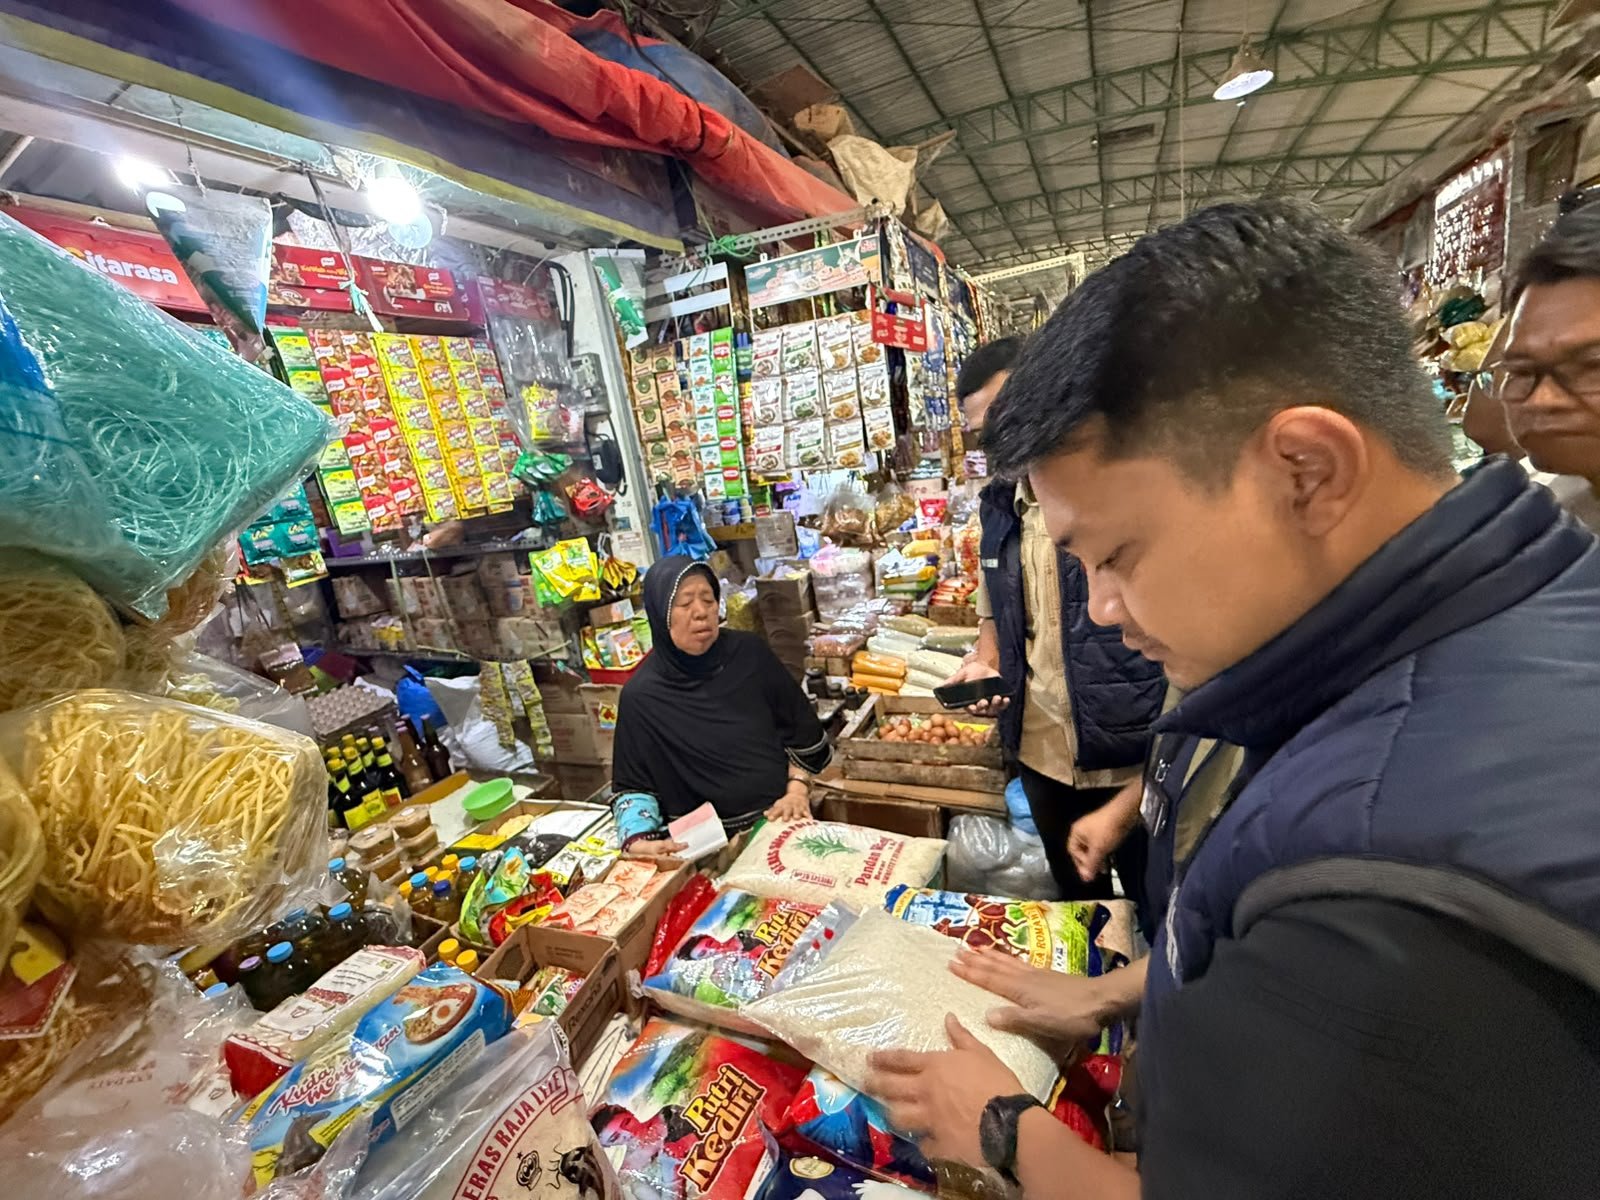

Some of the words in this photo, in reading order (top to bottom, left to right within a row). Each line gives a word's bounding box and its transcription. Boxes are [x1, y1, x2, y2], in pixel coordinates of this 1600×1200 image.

[66, 246, 179, 285] itarasa
[854, 845, 883, 887] Pandan
[758, 909, 816, 979] Kediri
[1028, 909, 1047, 950] ROMAWI
[268, 1068, 331, 1115] Kuda
[303, 1026, 402, 1105] Menjaan
[684, 1065, 744, 1131] Putri
[462, 1145, 502, 1200] ERAS
[494, 1100, 536, 1149] RAJA
[682, 1081, 762, 1190] Kediri
